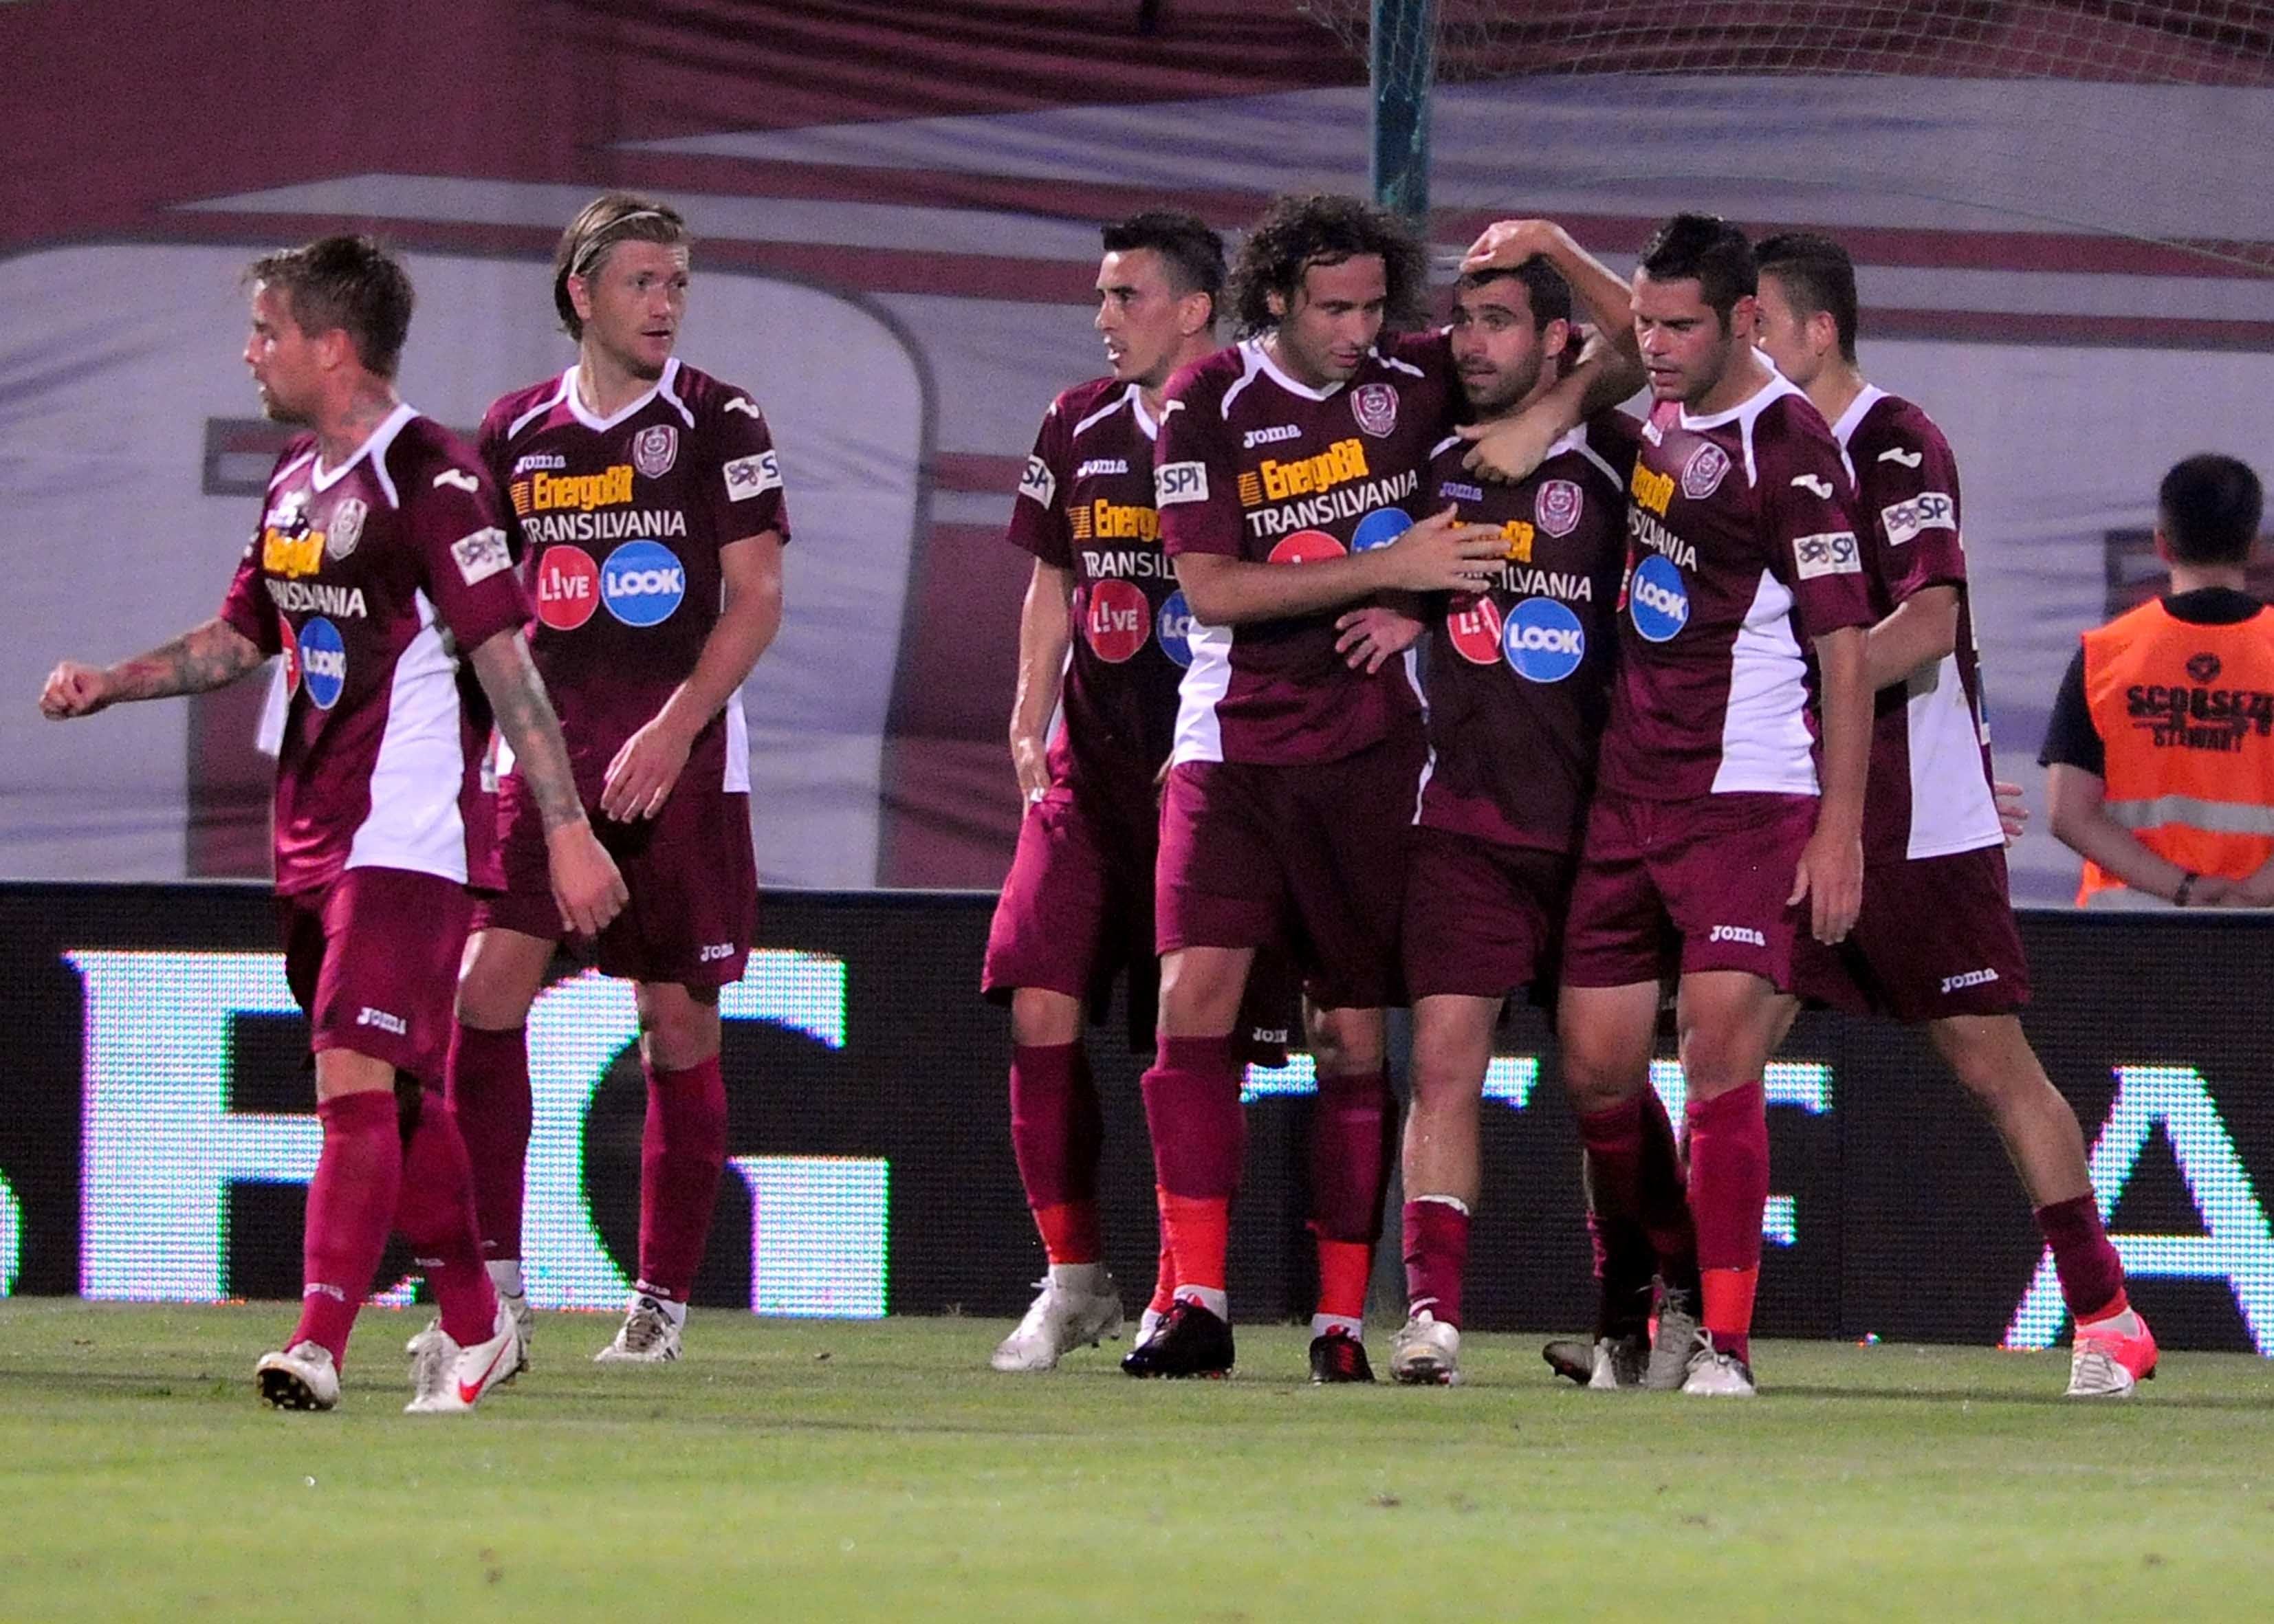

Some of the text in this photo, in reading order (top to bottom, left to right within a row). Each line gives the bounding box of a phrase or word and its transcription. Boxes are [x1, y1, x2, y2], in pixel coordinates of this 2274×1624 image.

[1244, 424, 1302, 448] Joma
[1261, 439, 1369, 501] EnergoBit
[1246, 469, 1418, 537] TRANSILVANIA
[521, 510, 686, 543] TRANSILVANIA
[1082, 551, 1177, 579] TRANSIL
[606, 568, 682, 597] LOOK
[1634, 574, 1687, 622] LOOK
[1509, 623, 1582, 654] LOOK
[1709, 925, 1766, 947] Joma
[1941, 968, 2000, 994] Joma
